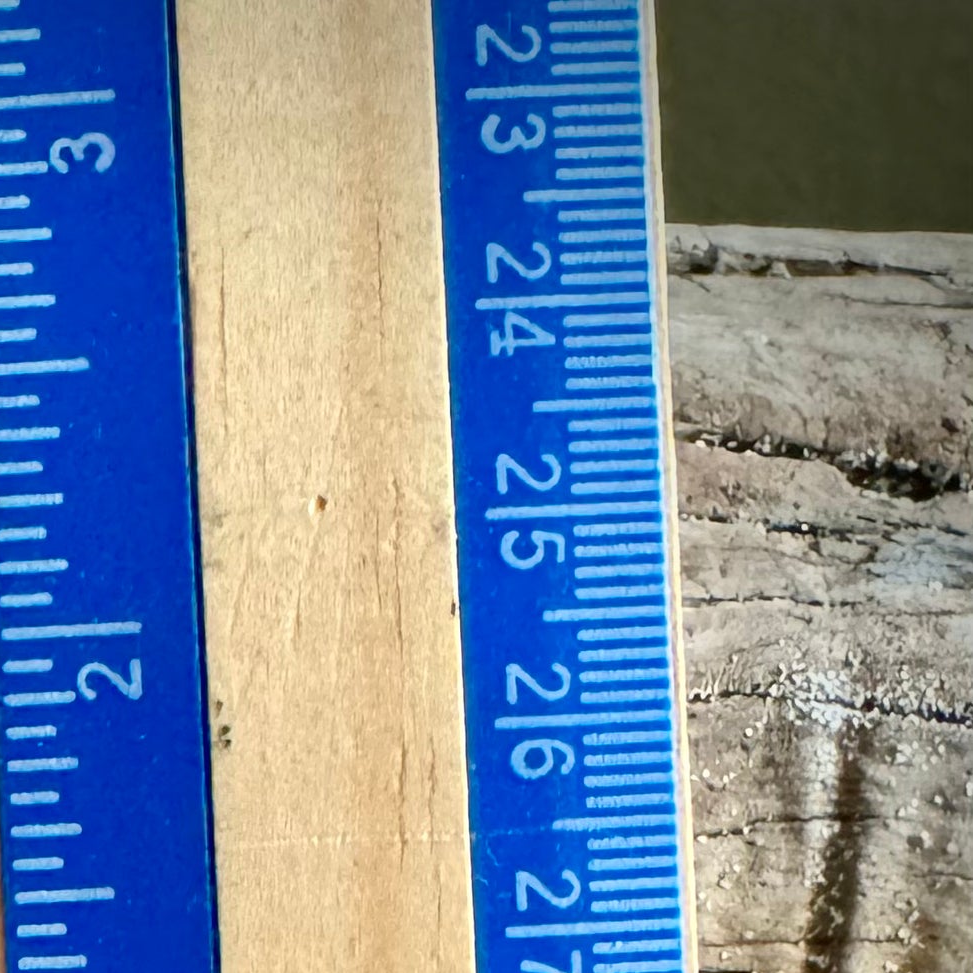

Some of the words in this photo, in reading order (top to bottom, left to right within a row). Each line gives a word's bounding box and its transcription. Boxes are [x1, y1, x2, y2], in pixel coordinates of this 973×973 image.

[475, 24, 547, 155] 23
[49, 130, 117, 174] 3
[485, 242, 556, 359] 24
[494, 453, 566, 571] 25
[76, 658, 143, 702] 2
[503, 662, 576, 781] 26
